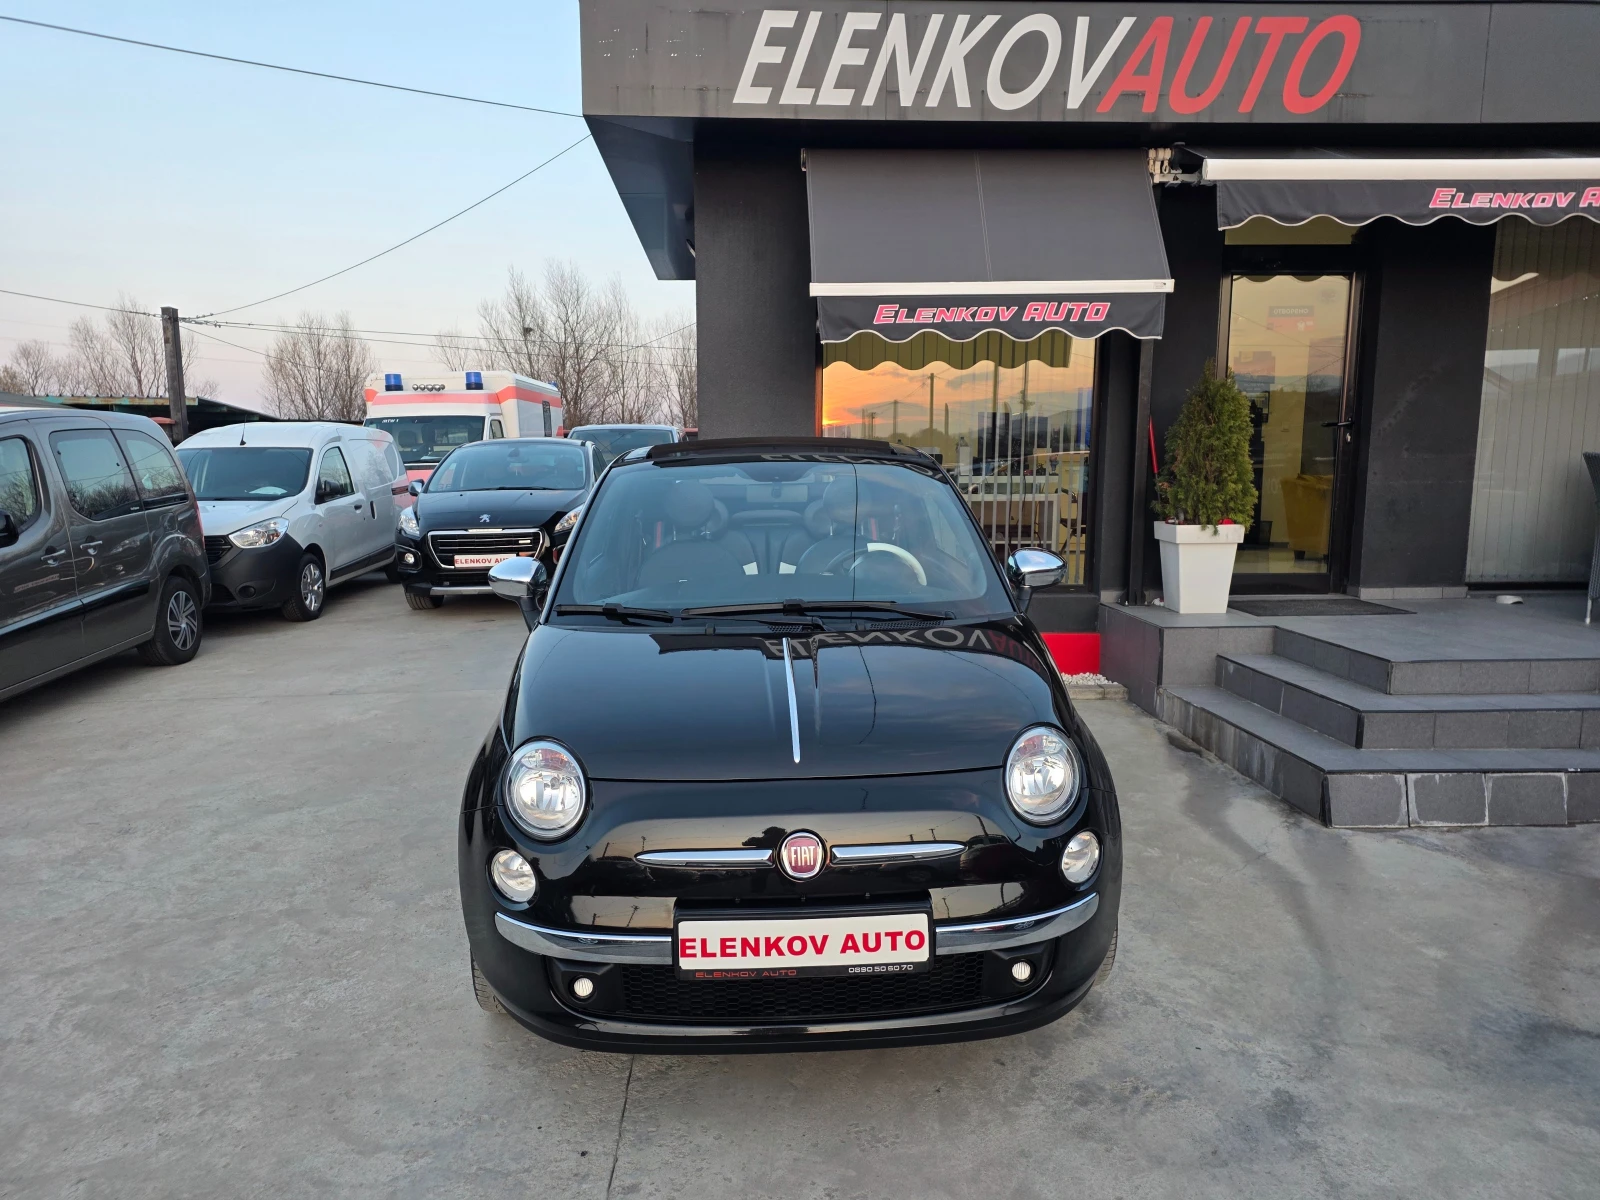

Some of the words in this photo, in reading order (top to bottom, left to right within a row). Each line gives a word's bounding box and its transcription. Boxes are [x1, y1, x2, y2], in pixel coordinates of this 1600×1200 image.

[1429, 187, 1576, 209] ELENKOV
[873, 303, 1018, 325] ELENKOV
[1022, 301, 1111, 322] AUTO
[791, 845, 815, 867] FIAT
[679, 934, 829, 959] ELENKOV
[840, 929, 926, 955] AUTO
[761, 969, 797, 977] AUTO
